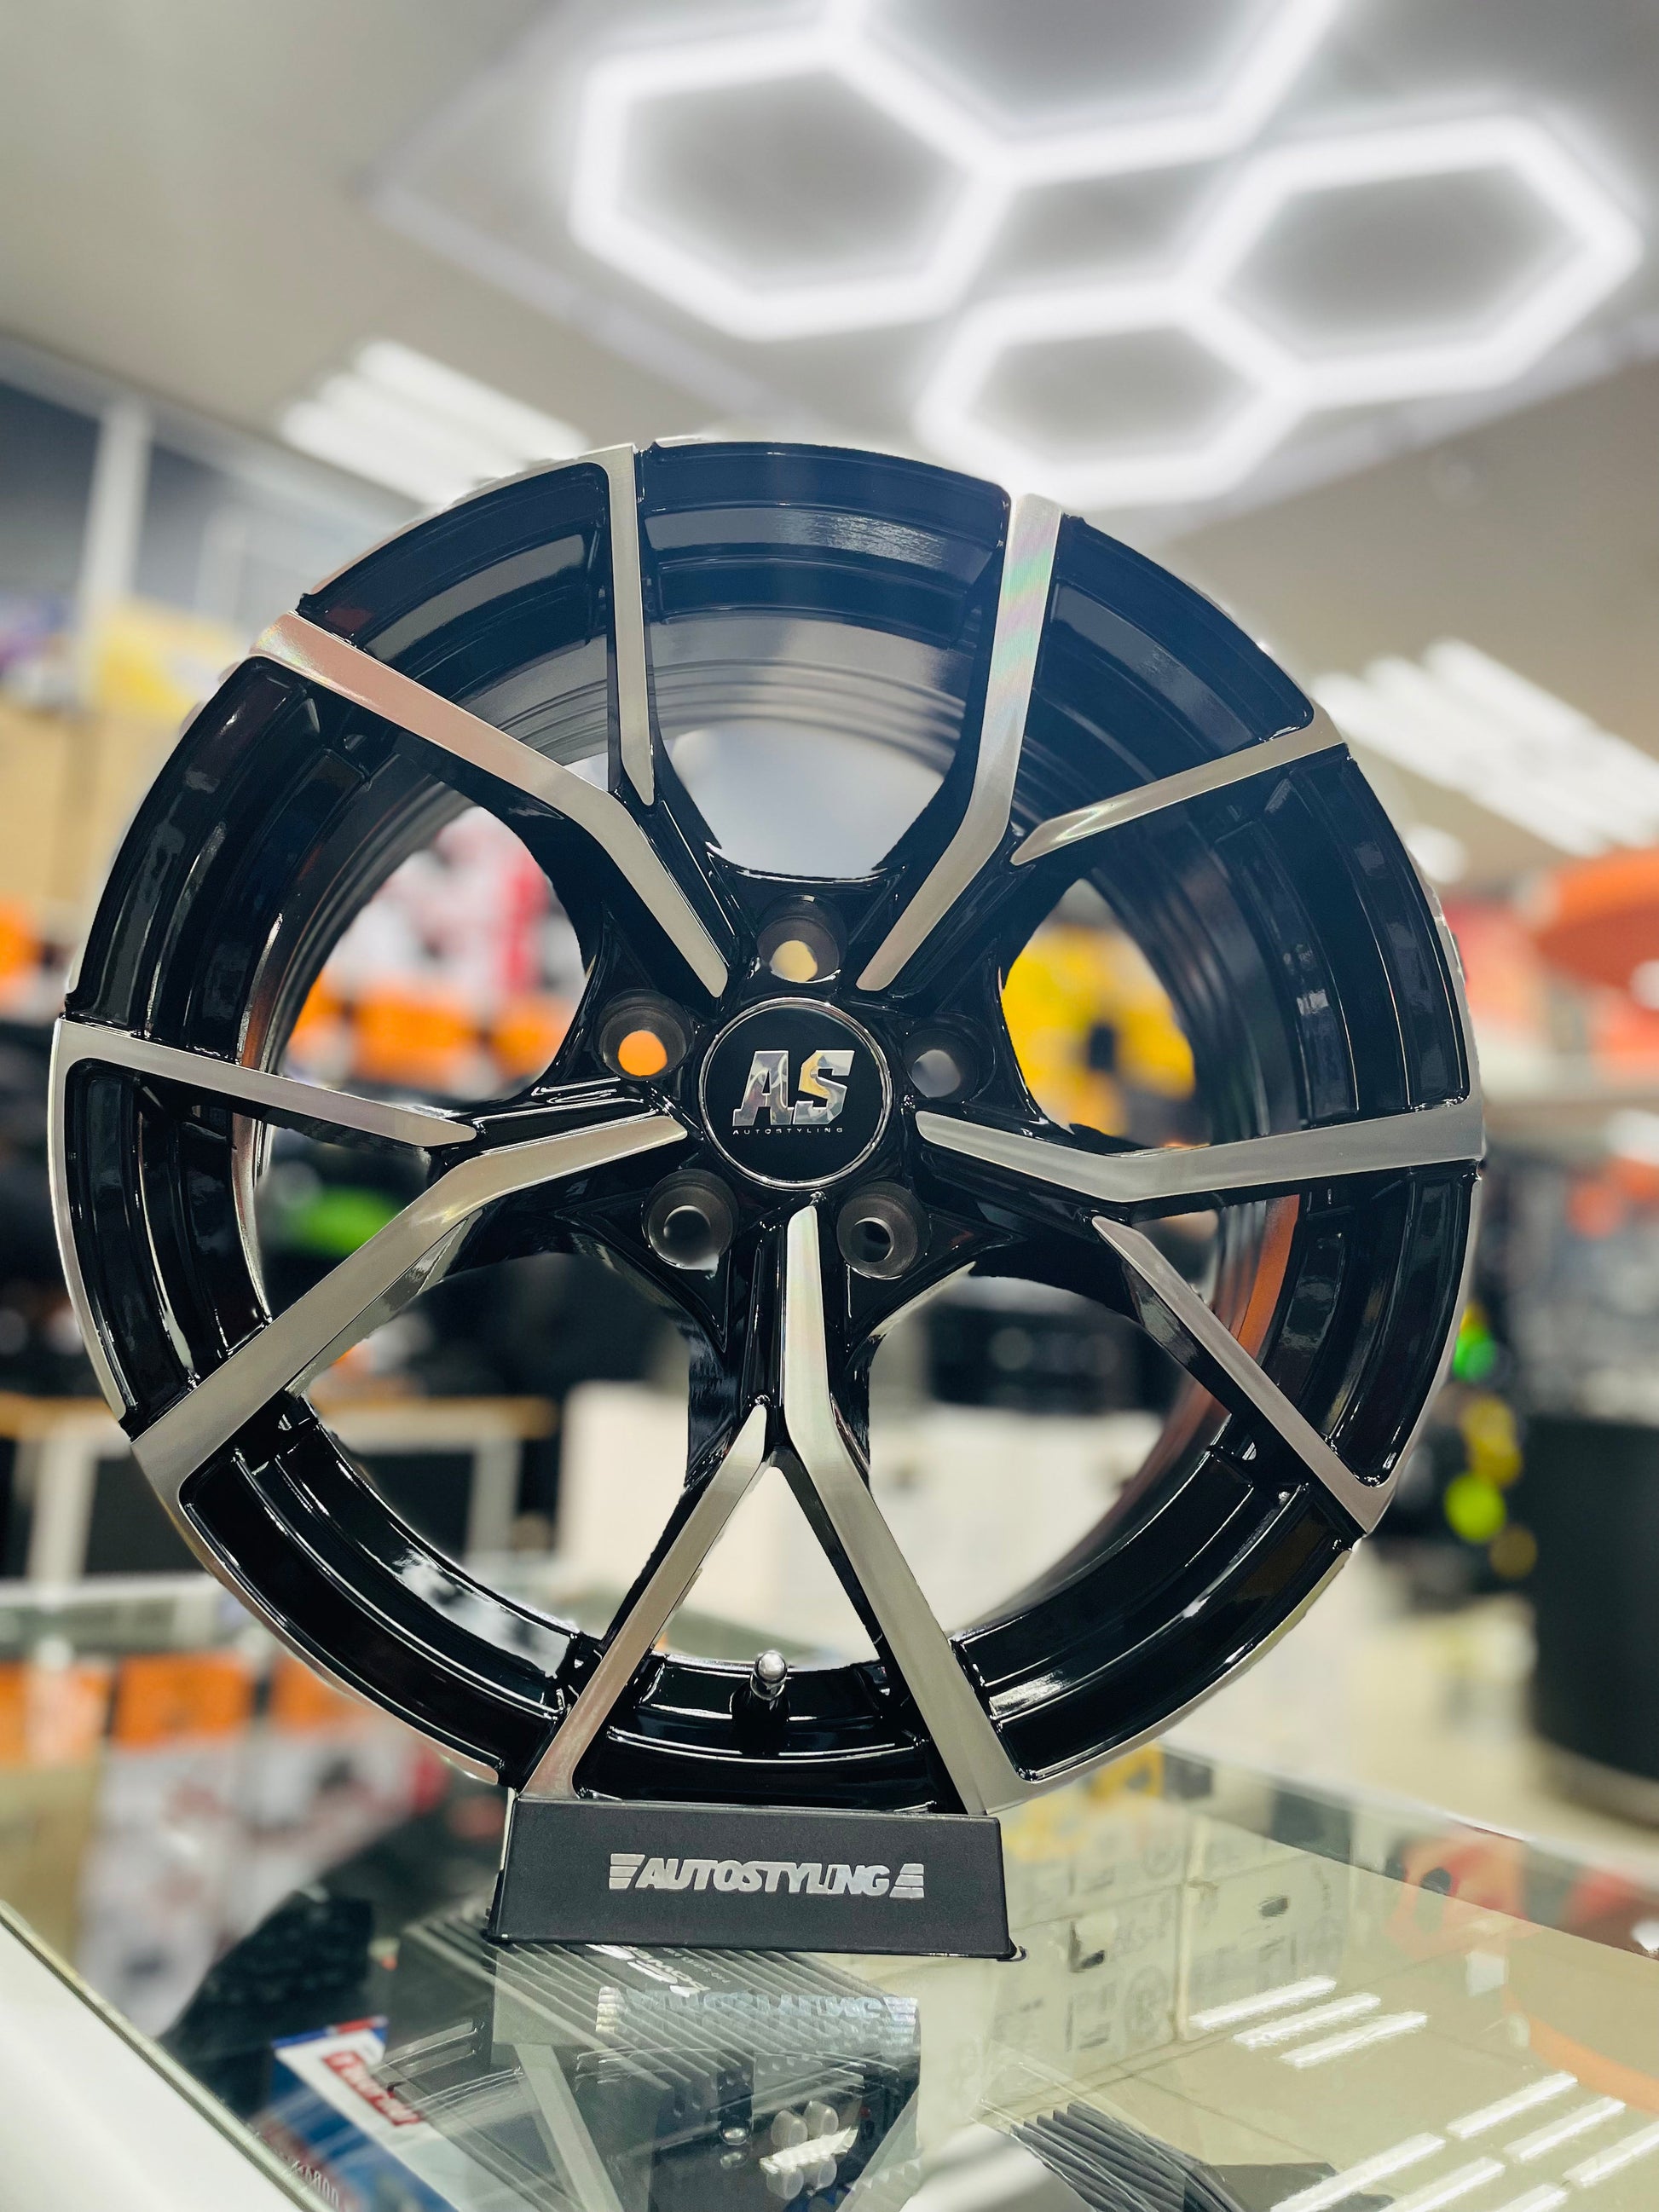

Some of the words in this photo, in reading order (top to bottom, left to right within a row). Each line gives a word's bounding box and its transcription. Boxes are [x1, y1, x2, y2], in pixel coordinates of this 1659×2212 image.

[731, 1049, 855, 1127] AS
[732, 1126, 843, 1135] AUTOSTYLING
[634, 1857, 891, 1897] AUTOSTYLING
